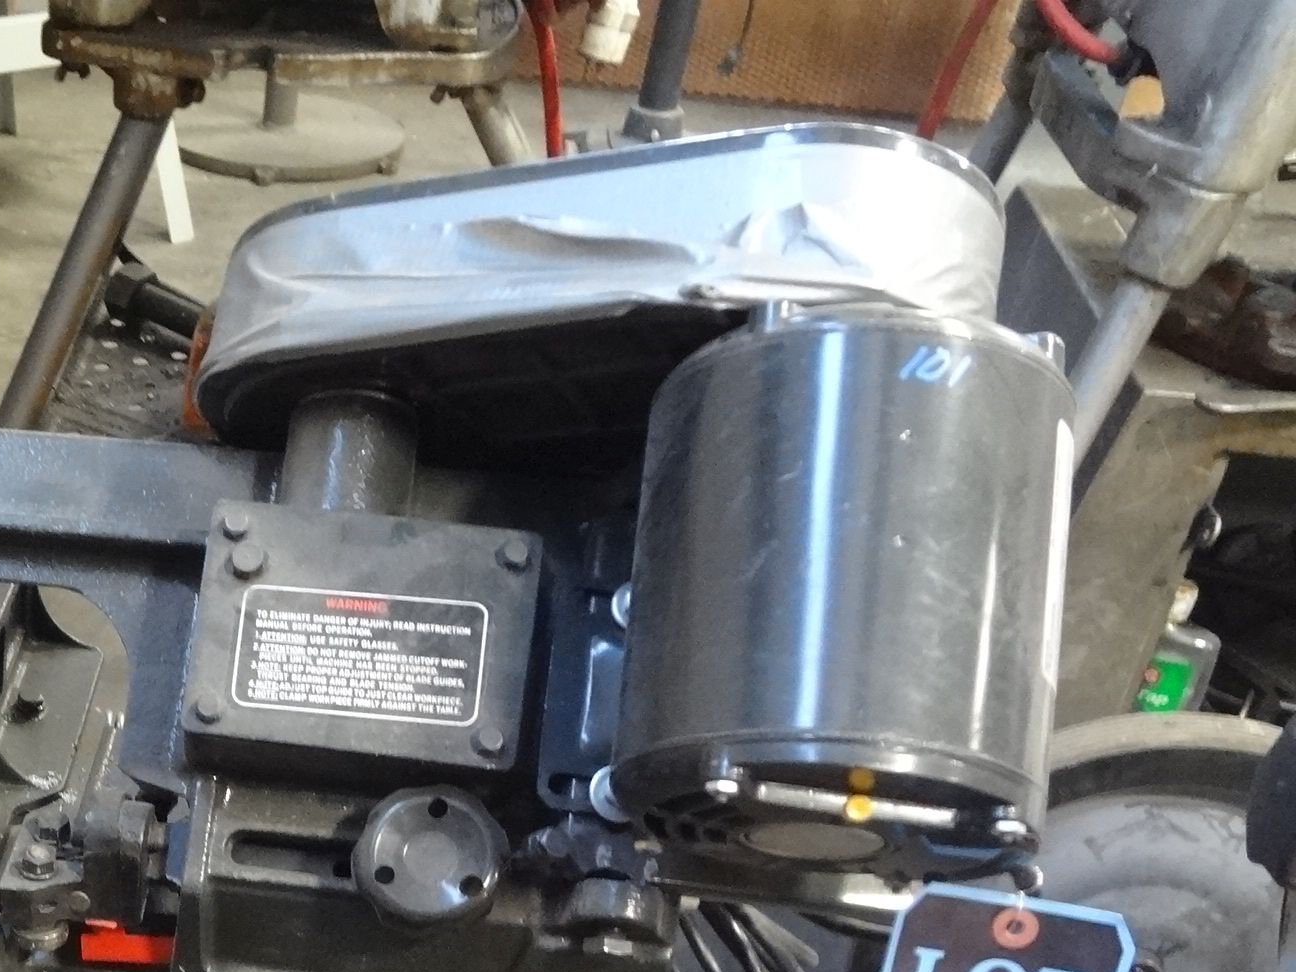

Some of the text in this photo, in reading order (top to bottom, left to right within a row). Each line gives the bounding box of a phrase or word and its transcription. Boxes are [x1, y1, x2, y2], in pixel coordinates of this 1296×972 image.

[900, 346, 972, 388] 101
[325, 598, 387, 614] WARNING
[256, 609, 268, 618] TO
[270, 611, 310, 622] ELIMINATE
[313, 614, 346, 625] DANGER
[347, 617, 359, 626] OF
[394, 621, 414, 631] READ
[417, 622, 471, 635] INSTRUCTION
[256, 619, 289, 629] MANUAL
[293, 622, 323, 632] BEFORE
[310, 635, 325, 644] USE
[329, 637, 358, 647] SAFETY
[307, 647, 318, 655] DO
[320, 648, 336, 657] NOT
[338, 650, 371, 660] REMOVE
[373, 653, 407, 663] JAMMED
[409, 656, 439, 666] CUTOFF
[317, 657, 352, 667] MACHINE
[356, 661, 372, 669] HAS
[376, 662, 398, 671] BEEN
[257, 671, 288, 680] THRUST
[291, 674, 327, 684] BEARING
[329, 677, 348, 685] AND
[350, 679, 375, 688] BLADE
[282, 663, 303, 673] KEEP
[306, 665, 337, 676] PROPER
[339, 668, 393, 681] ADJUSTMENT
[406, 674, 431, 684] BLADE
[312, 685, 326, 694] TOP
[365, 690, 386, 699] JUST
[387, 692, 412, 701] CLEAR
[279, 691, 307, 702] CLAMP
[308, 694, 351, 706] WORKPIECE
[382, 701, 416, 711] AGAINST
[418, 704, 434, 713] THE
